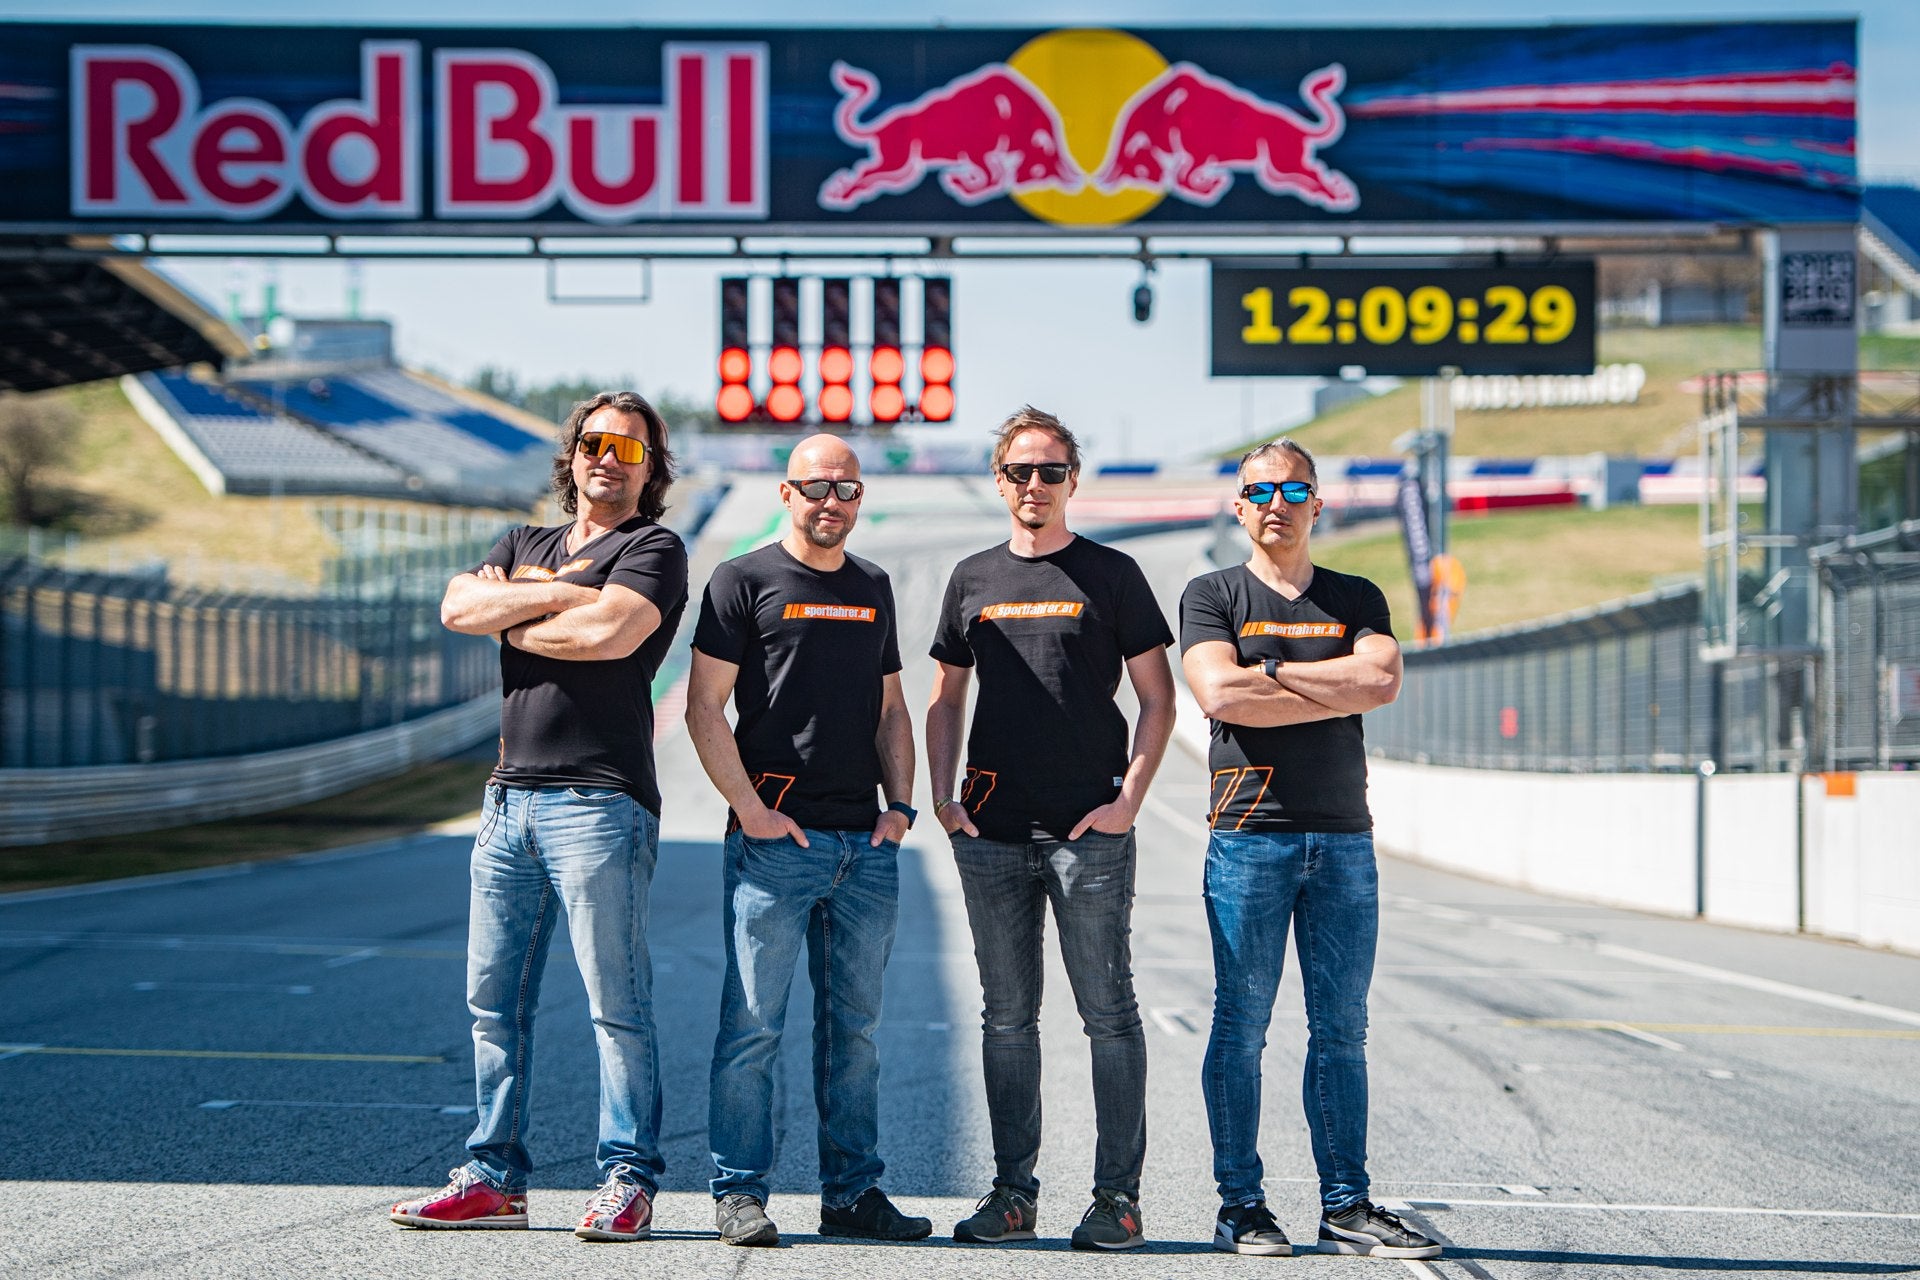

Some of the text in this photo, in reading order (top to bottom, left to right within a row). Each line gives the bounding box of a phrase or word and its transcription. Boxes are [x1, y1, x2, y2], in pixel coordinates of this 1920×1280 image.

[80, 46, 761, 212] Red Bull
[1241, 285, 1577, 345] 12:09:29
[804, 605, 870, 619] sportfahrer.at
[997, 603, 1075, 617] sportfahrer.at
[1263, 623, 1341, 636] sportfahrer.at
